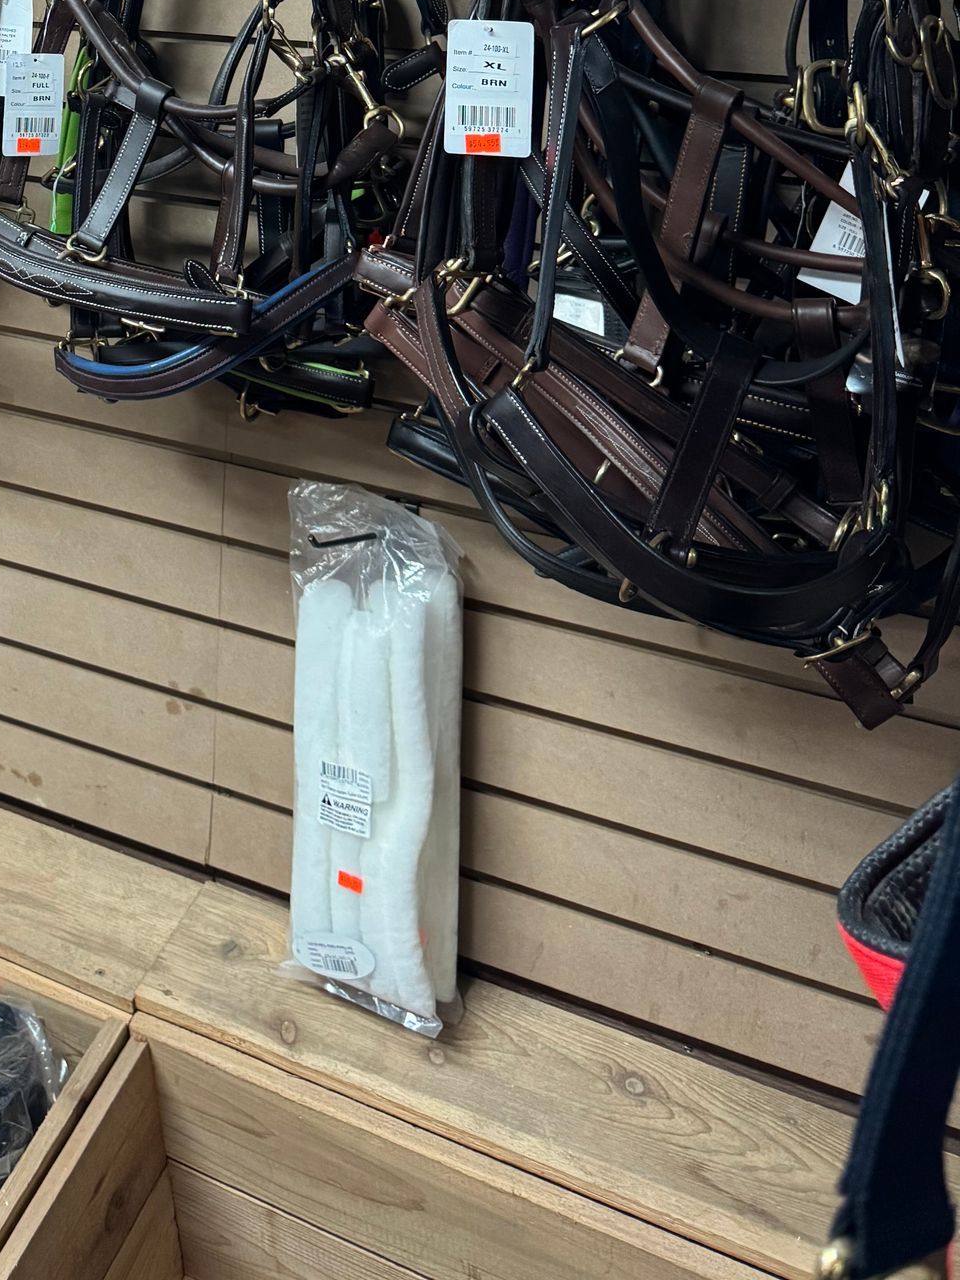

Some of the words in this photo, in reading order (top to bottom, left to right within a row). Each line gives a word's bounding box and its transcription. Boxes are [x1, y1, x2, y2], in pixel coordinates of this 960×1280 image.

[483, 44, 510, 54] 24-100-XL
[483, 61, 507, 71] XL
[481, 78, 507, 87] BRN
[332, 799, 369, 816] WARNING
